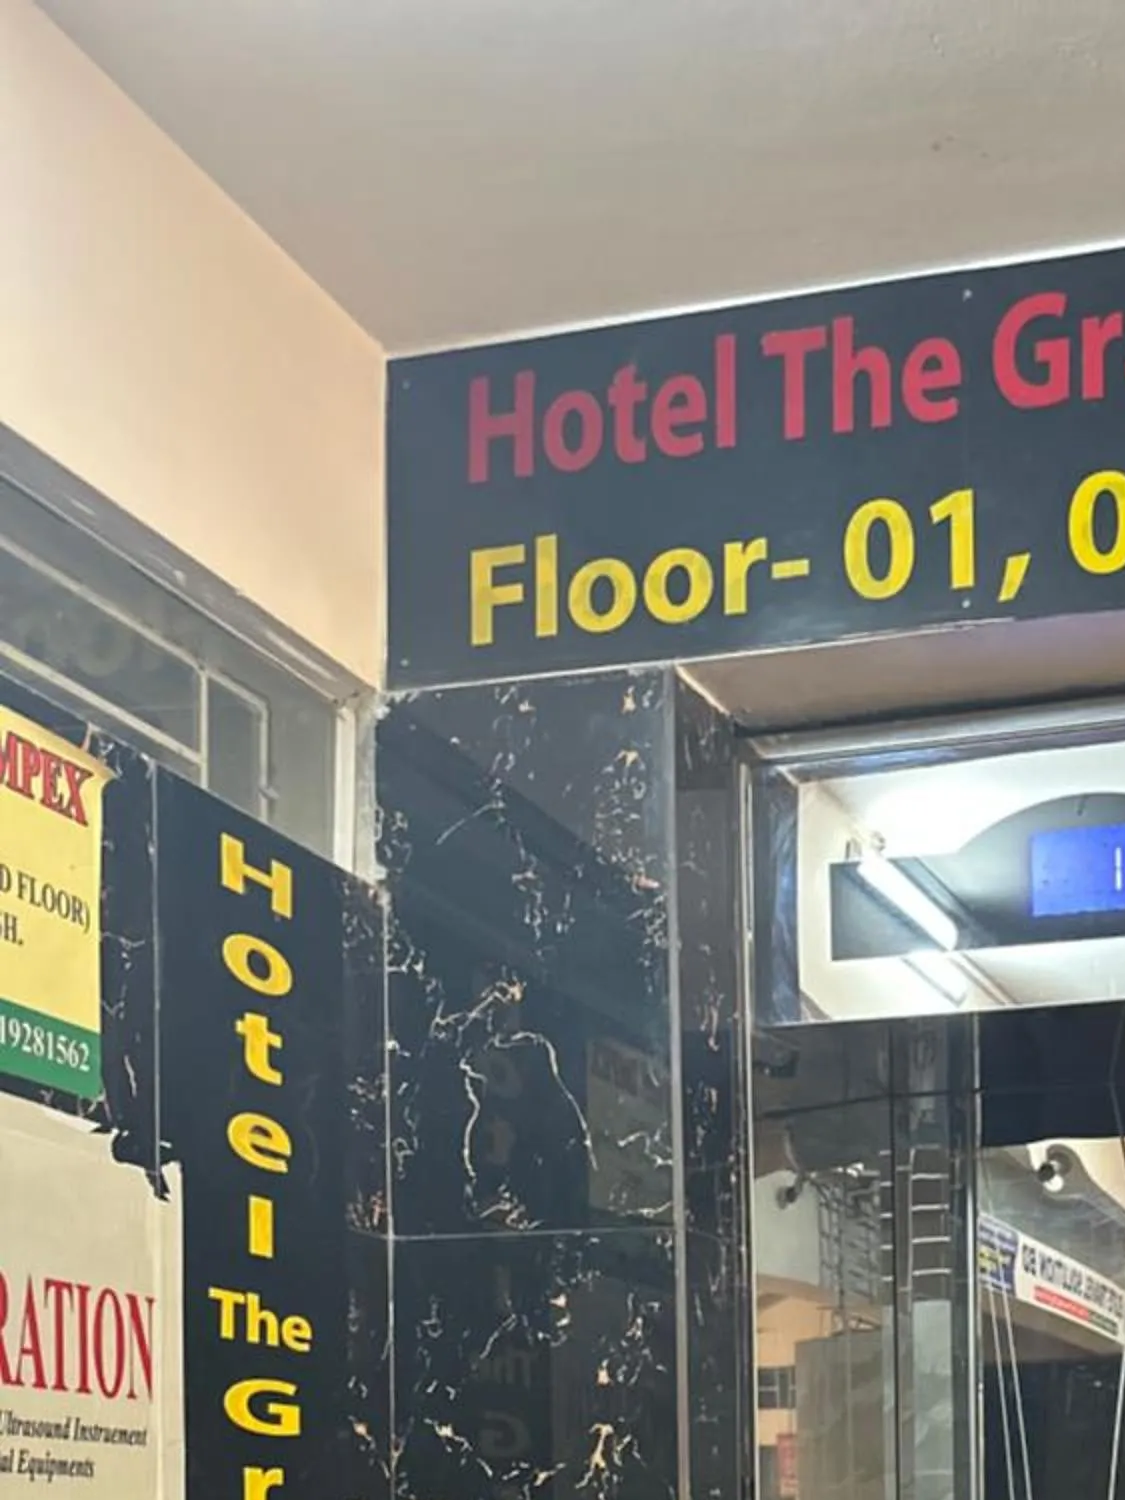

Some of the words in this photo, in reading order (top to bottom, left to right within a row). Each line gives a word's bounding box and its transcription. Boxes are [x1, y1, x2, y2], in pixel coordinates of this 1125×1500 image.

[467, 334, 737, 483] Hotel
[761, 316, 964, 440] The
[470, 533, 810, 645] Floor-
[842, 488, 1031, 602] 01,
[17, 870, 91, 934] FLOOR)
[220, 832, 294, 1259] Hotel
[208, 1286, 313, 1352] The
